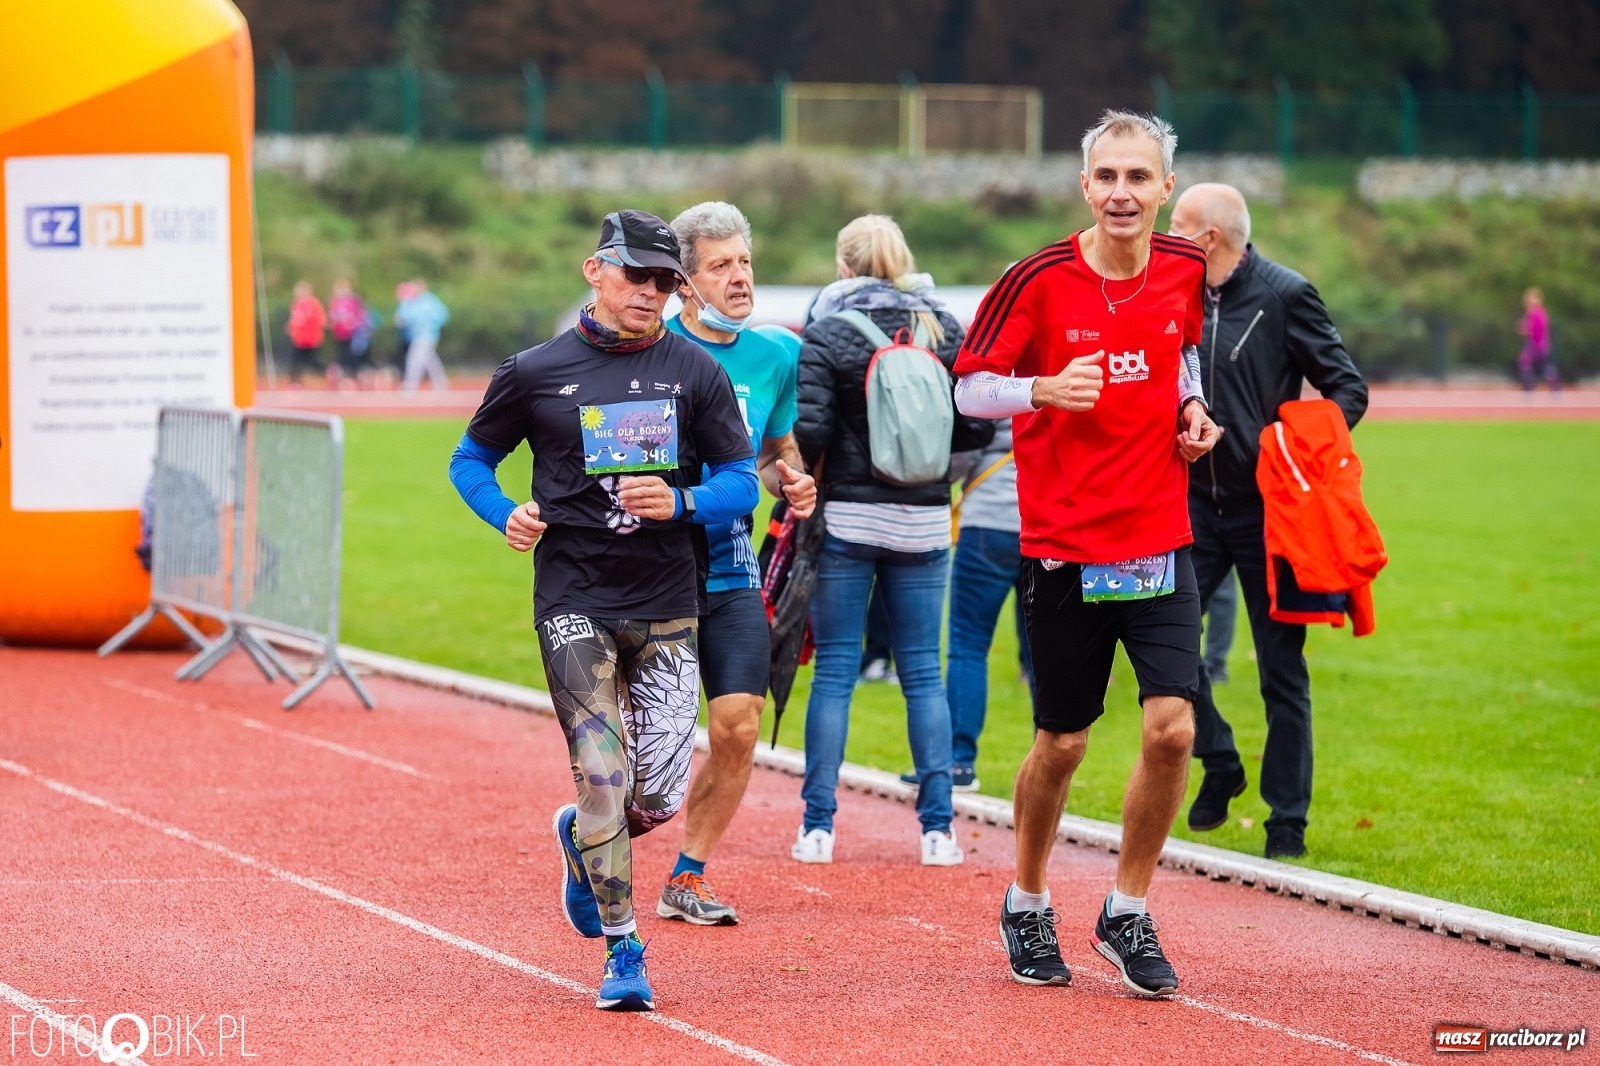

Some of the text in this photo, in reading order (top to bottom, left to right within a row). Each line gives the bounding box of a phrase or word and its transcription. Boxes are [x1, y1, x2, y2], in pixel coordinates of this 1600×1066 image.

[1109, 350, 1149, 375] bbl
[594, 429, 613, 439] BIEG
[618, 428, 635, 436] DLA
[640, 448, 670, 464] 348
